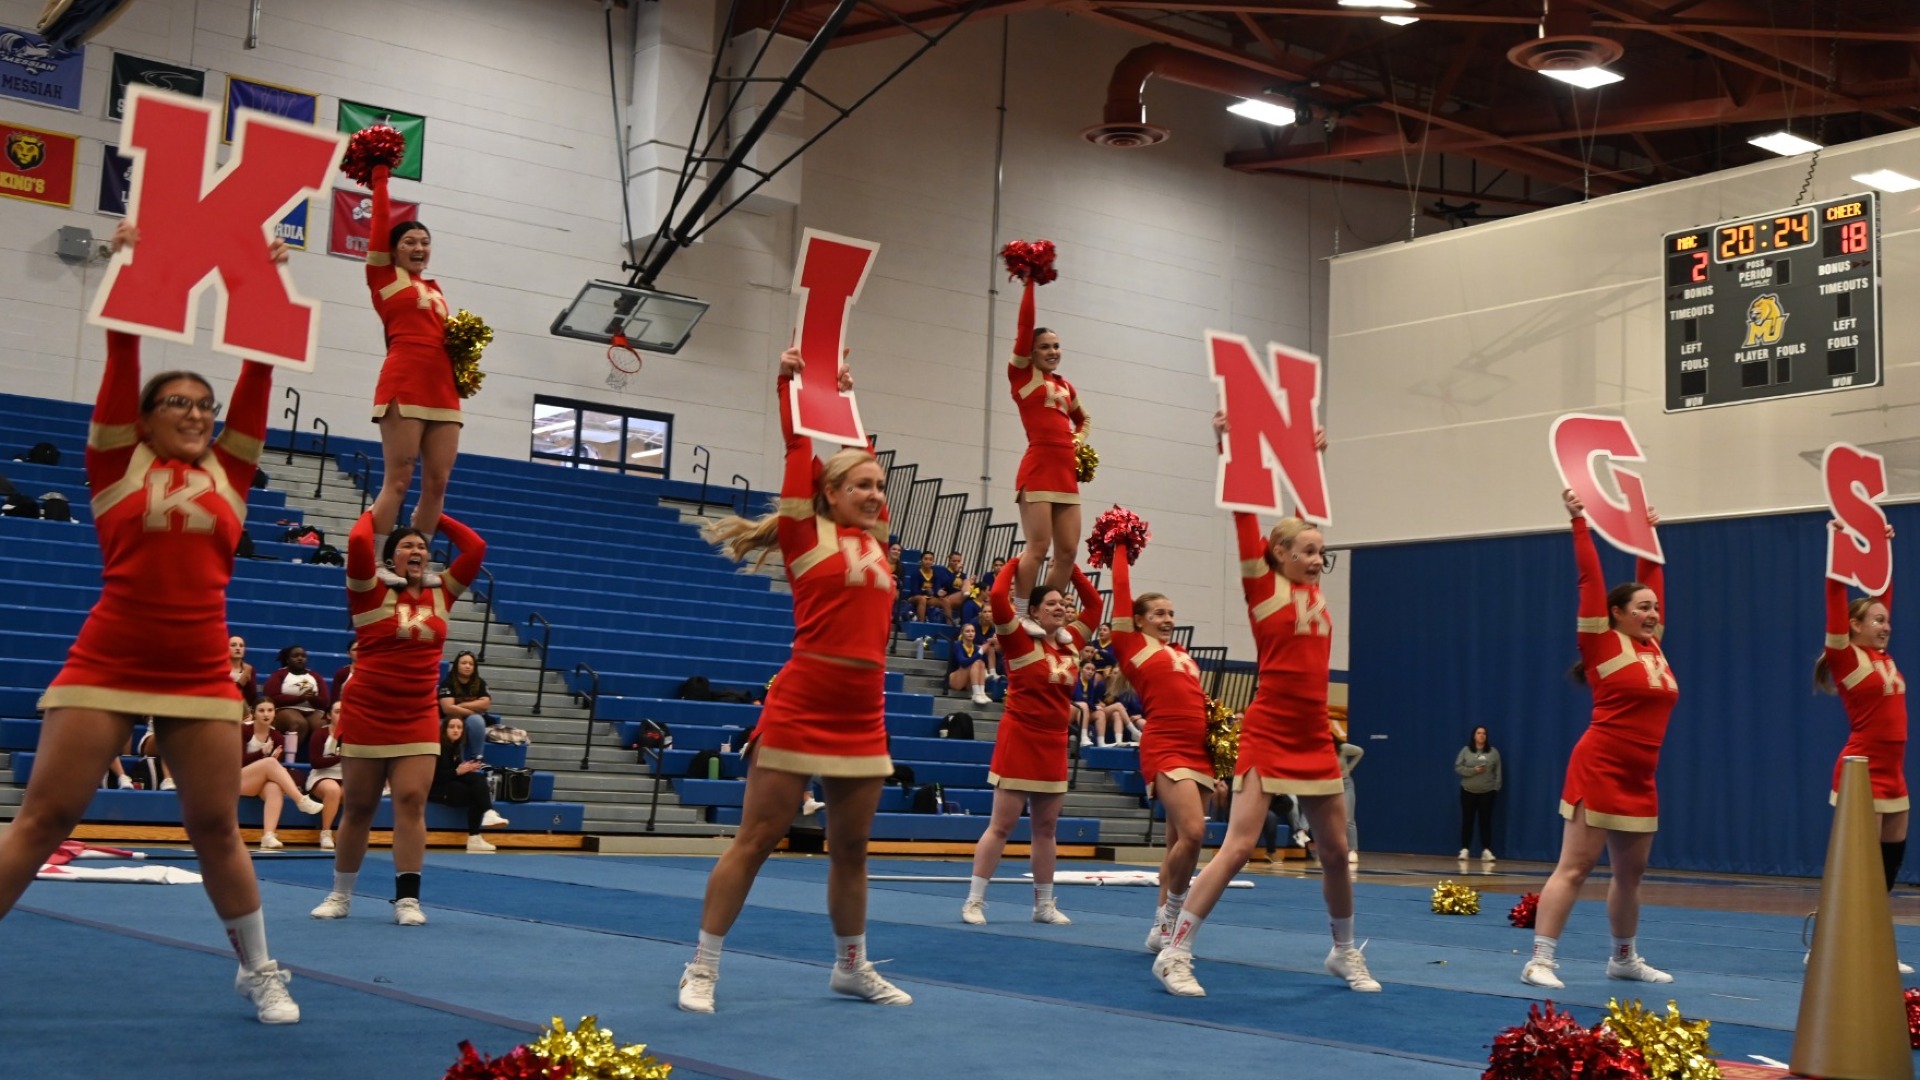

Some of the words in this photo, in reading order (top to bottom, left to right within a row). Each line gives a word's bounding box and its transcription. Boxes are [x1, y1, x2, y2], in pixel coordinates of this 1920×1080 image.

[1, 74, 63, 99] MESSIAH
[0, 171, 46, 194] KING'S
[1826, 202, 1862, 221] CHEER
[86, 82, 347, 373] K
[275, 223, 305, 241] RDIA
[1841, 220, 1868, 254] 18
[1676, 235, 1698, 251] MAC
[1692, 251, 1709, 282] 2
[1739, 266, 1773, 283] PERIOD
[1745, 259, 1765, 269] POSS
[1818, 261, 1850, 276] BONUS
[1684, 285, 1714, 300] BONUS
[1819, 277, 1869, 296] TIMEOUTS
[1670, 304, 1715, 321] TIMEOUTS
[1833, 317, 1858, 331] LEFT
[790, 226, 881, 447] I
[1742, 313, 1790, 349] MU
[1827, 335, 1859, 349] FOULS
[1681, 342, 1703, 355] LEFT
[1735, 348, 1769, 363] PLAYER
[1776, 343, 1806, 357] FOULS
[1681, 358, 1709, 371] FOULS
[1832, 376, 1853, 387] WON
[1043, 379, 1073, 415] K
[1685, 396, 1704, 407] WON
[1204, 329, 1332, 526] N
[142, 466, 218, 535] K
[1549, 413, 1665, 564] G
[1822, 441, 1892, 596] S
[839, 536, 892, 591] K
[395, 603, 436, 642] K
[1293, 588, 1332, 637] K
[1046, 655, 1079, 686] K
[1638, 652, 1678, 692] K
[1872, 659, 1905, 696] K
